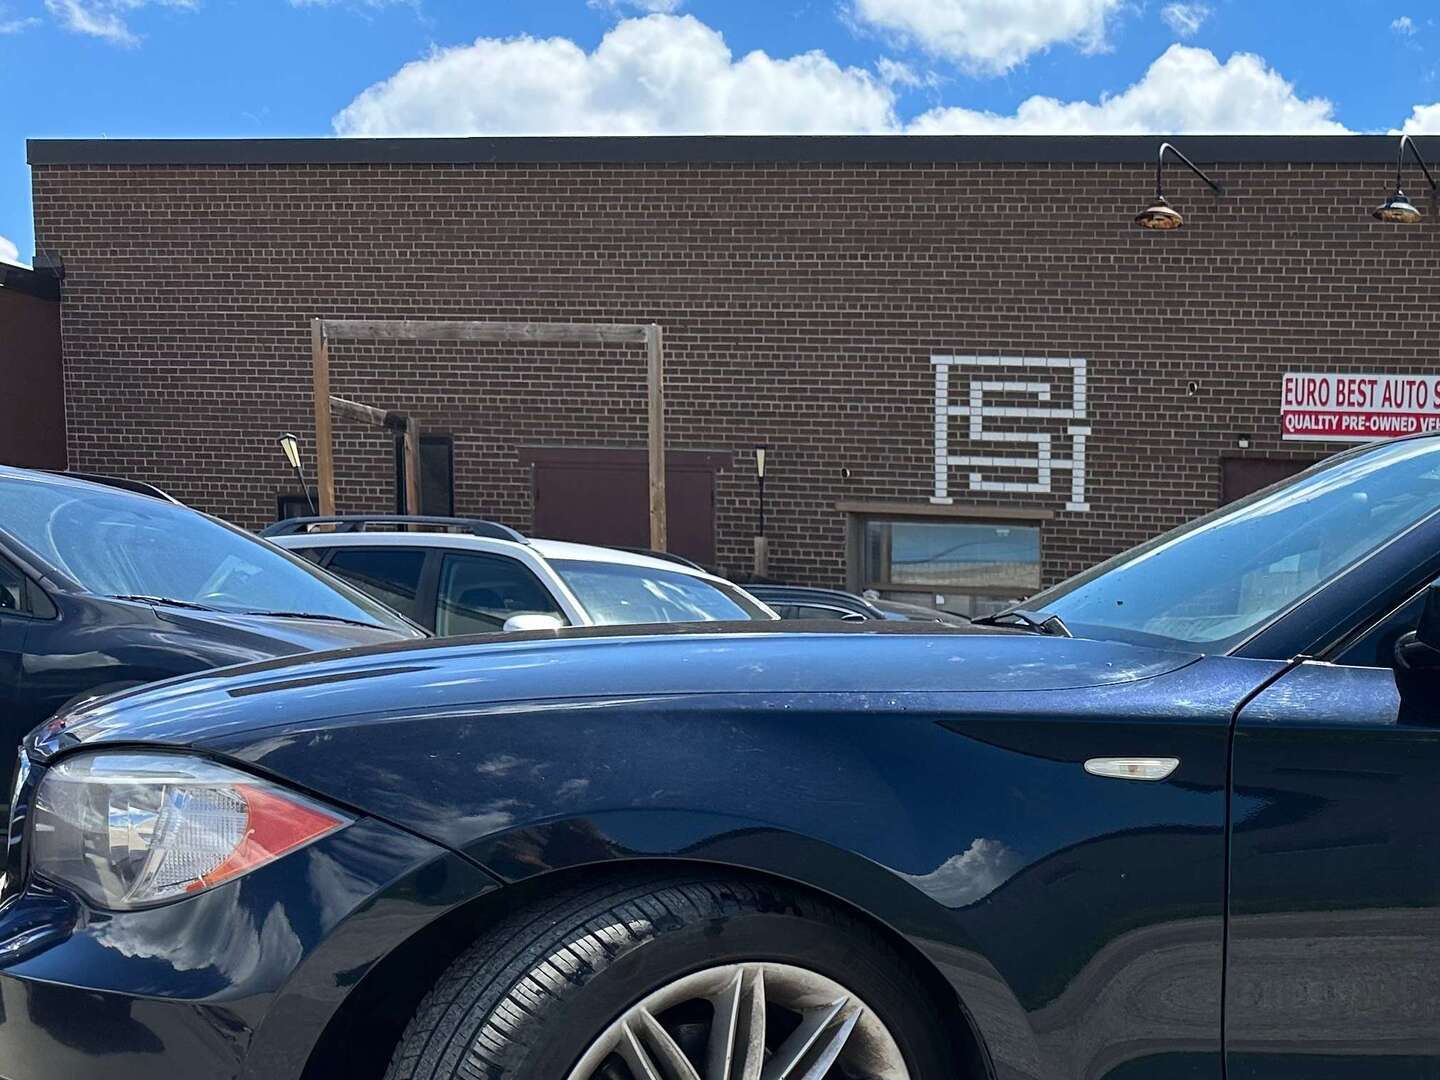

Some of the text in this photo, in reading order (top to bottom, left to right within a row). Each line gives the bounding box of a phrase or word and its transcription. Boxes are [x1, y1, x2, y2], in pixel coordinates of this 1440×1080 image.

[1284, 377, 1330, 407] EURO
[1336, 378, 1378, 409] BEST
[1381, 380, 1428, 410] AUTO
[1285, 414, 1340, 432] QUALITY
[1342, 416, 1417, 432] PRE-OWNED
